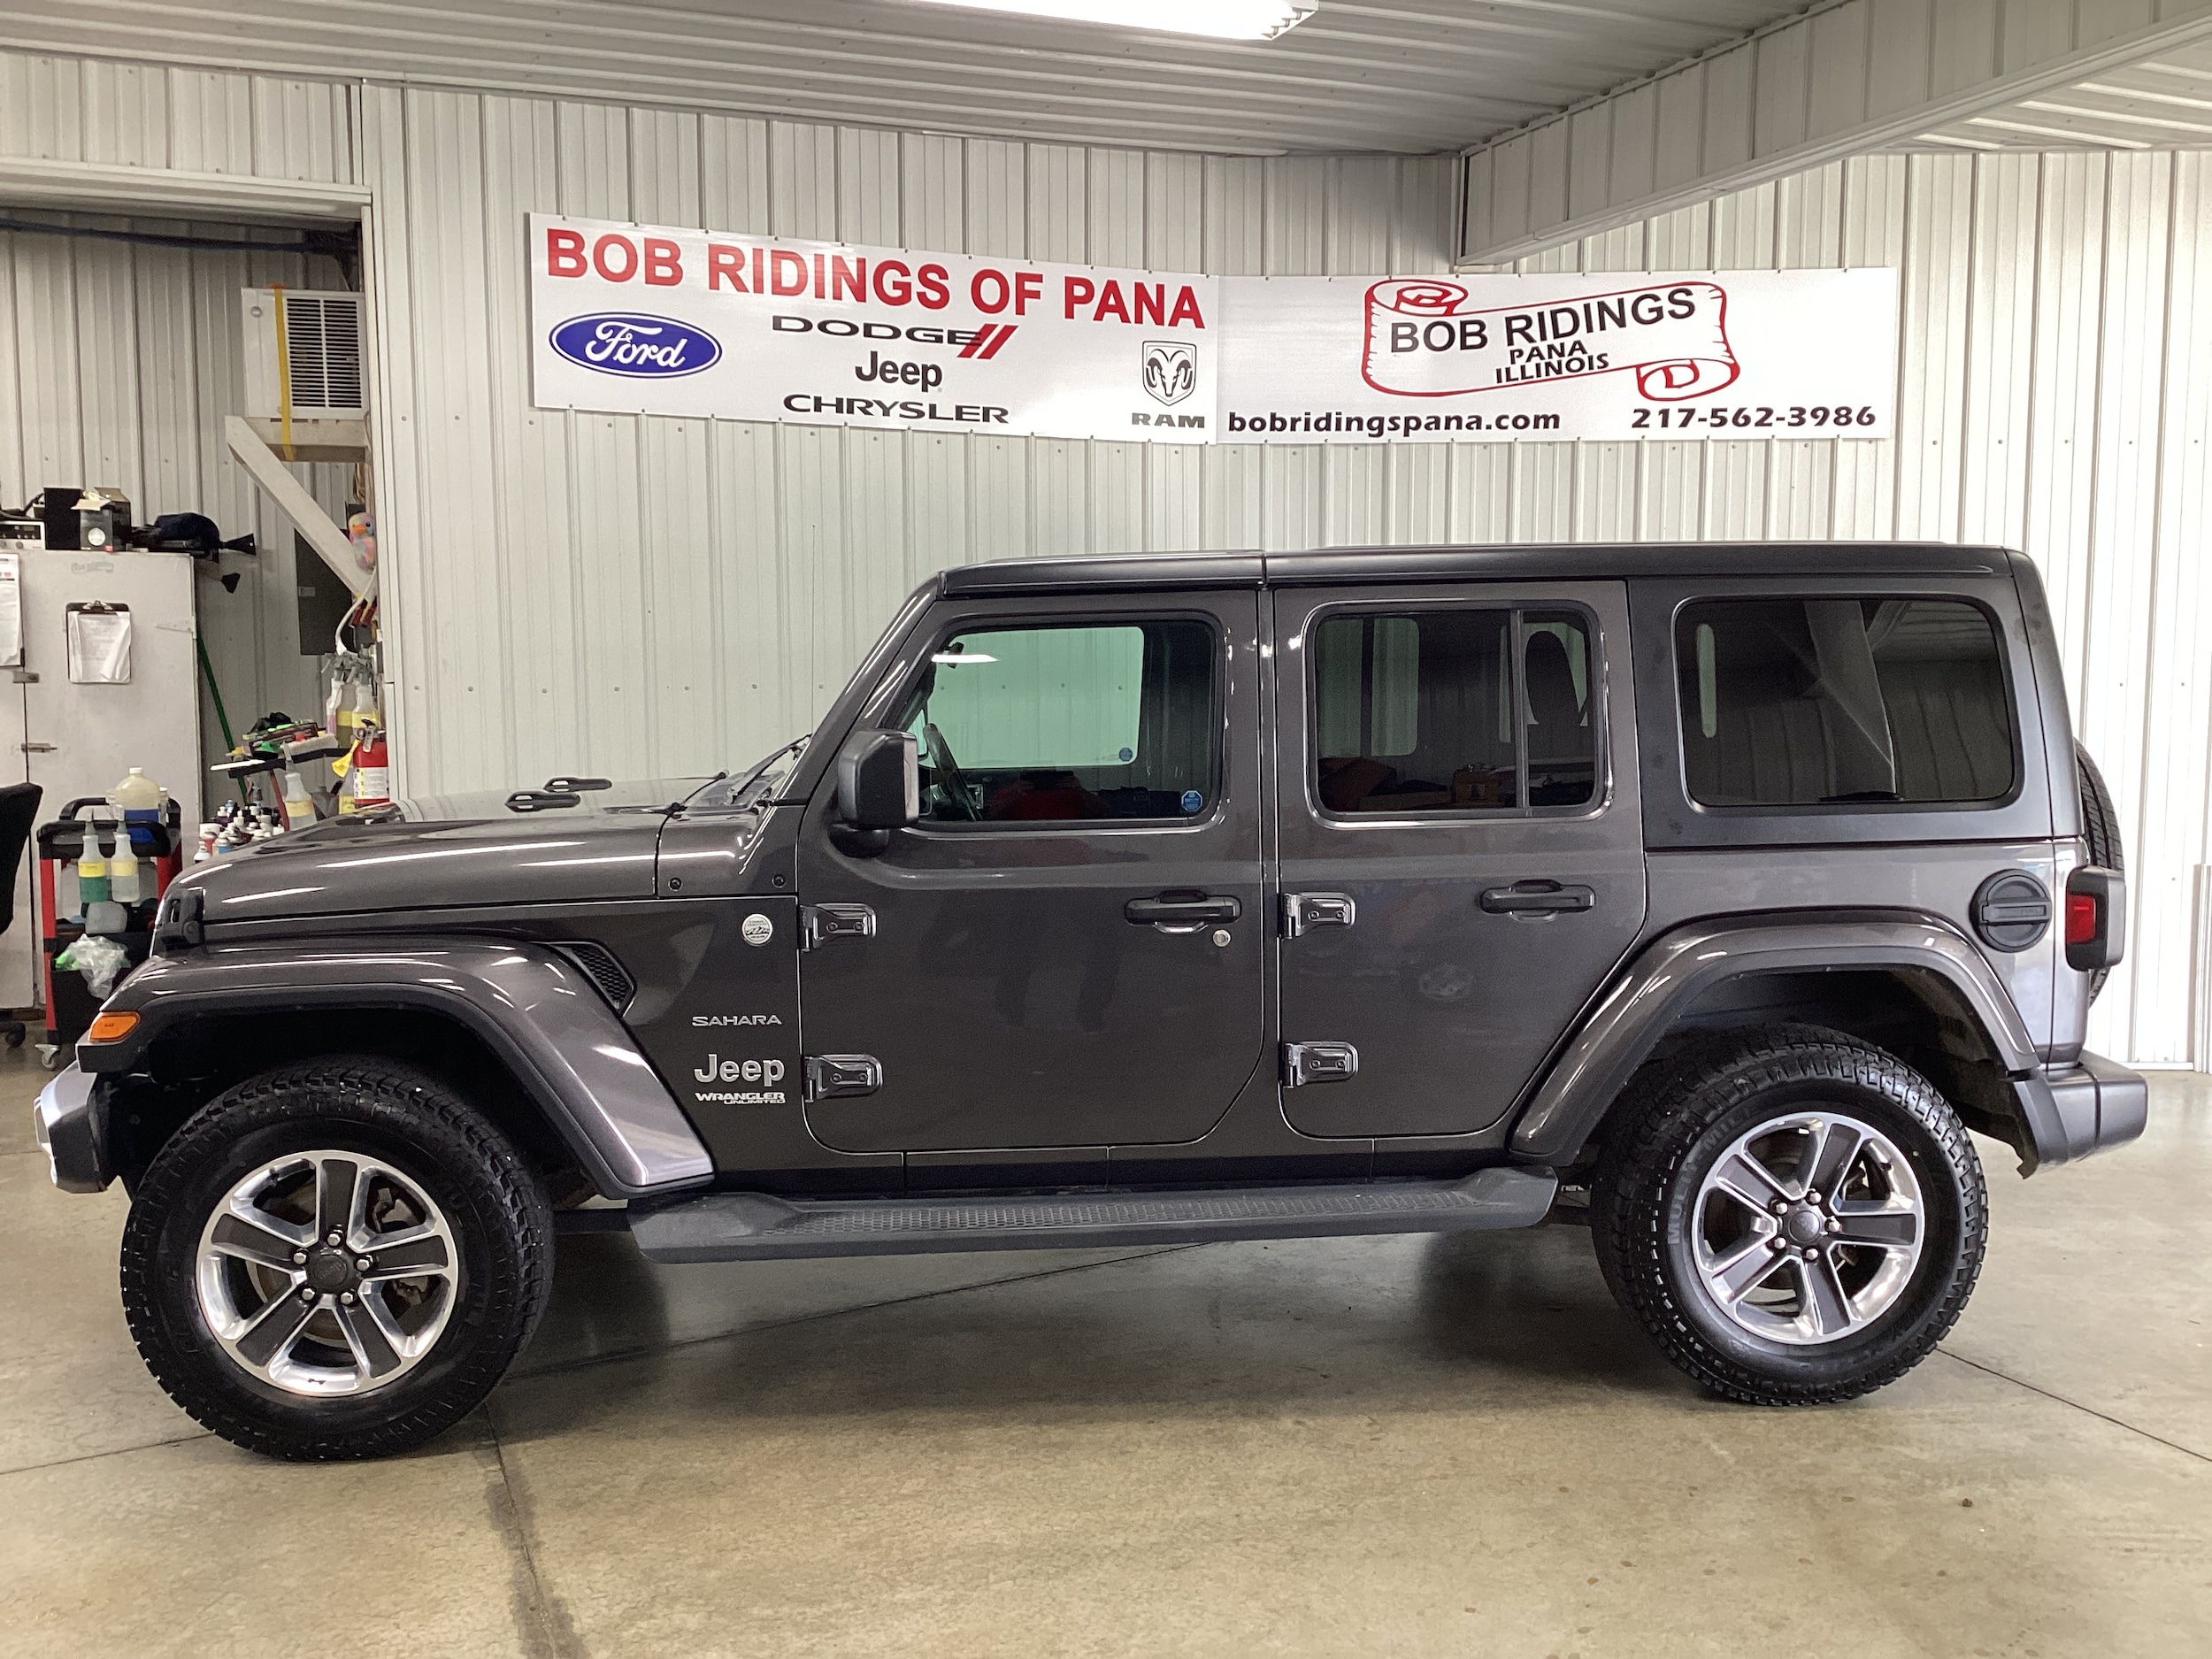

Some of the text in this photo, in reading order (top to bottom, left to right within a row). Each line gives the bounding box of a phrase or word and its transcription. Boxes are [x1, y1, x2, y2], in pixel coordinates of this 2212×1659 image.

[547, 228, 1206, 329] BOB RIDINGS OF PANA
[772, 315, 982, 346] DODGE
[1391, 288, 1696, 353] BOB RIDINGS
[585, 321, 688, 368] Ford
[1509, 340, 1588, 365] PANA
[855, 350, 943, 393] Jeep
[1495, 353, 1609, 383] ILLINOIS
[783, 394, 1010, 424] CHRYSLER
[1132, 412, 1205, 428] RAM
[1632, 406, 1876, 428] 217-562-3986
[1228, 411, 1561, 438] bobridingspana.com
[692, 1014, 783, 1027] SAHARA
[694, 1053, 786, 1087] Jeep
[695, 1092, 786, 1102] WRANGLER
